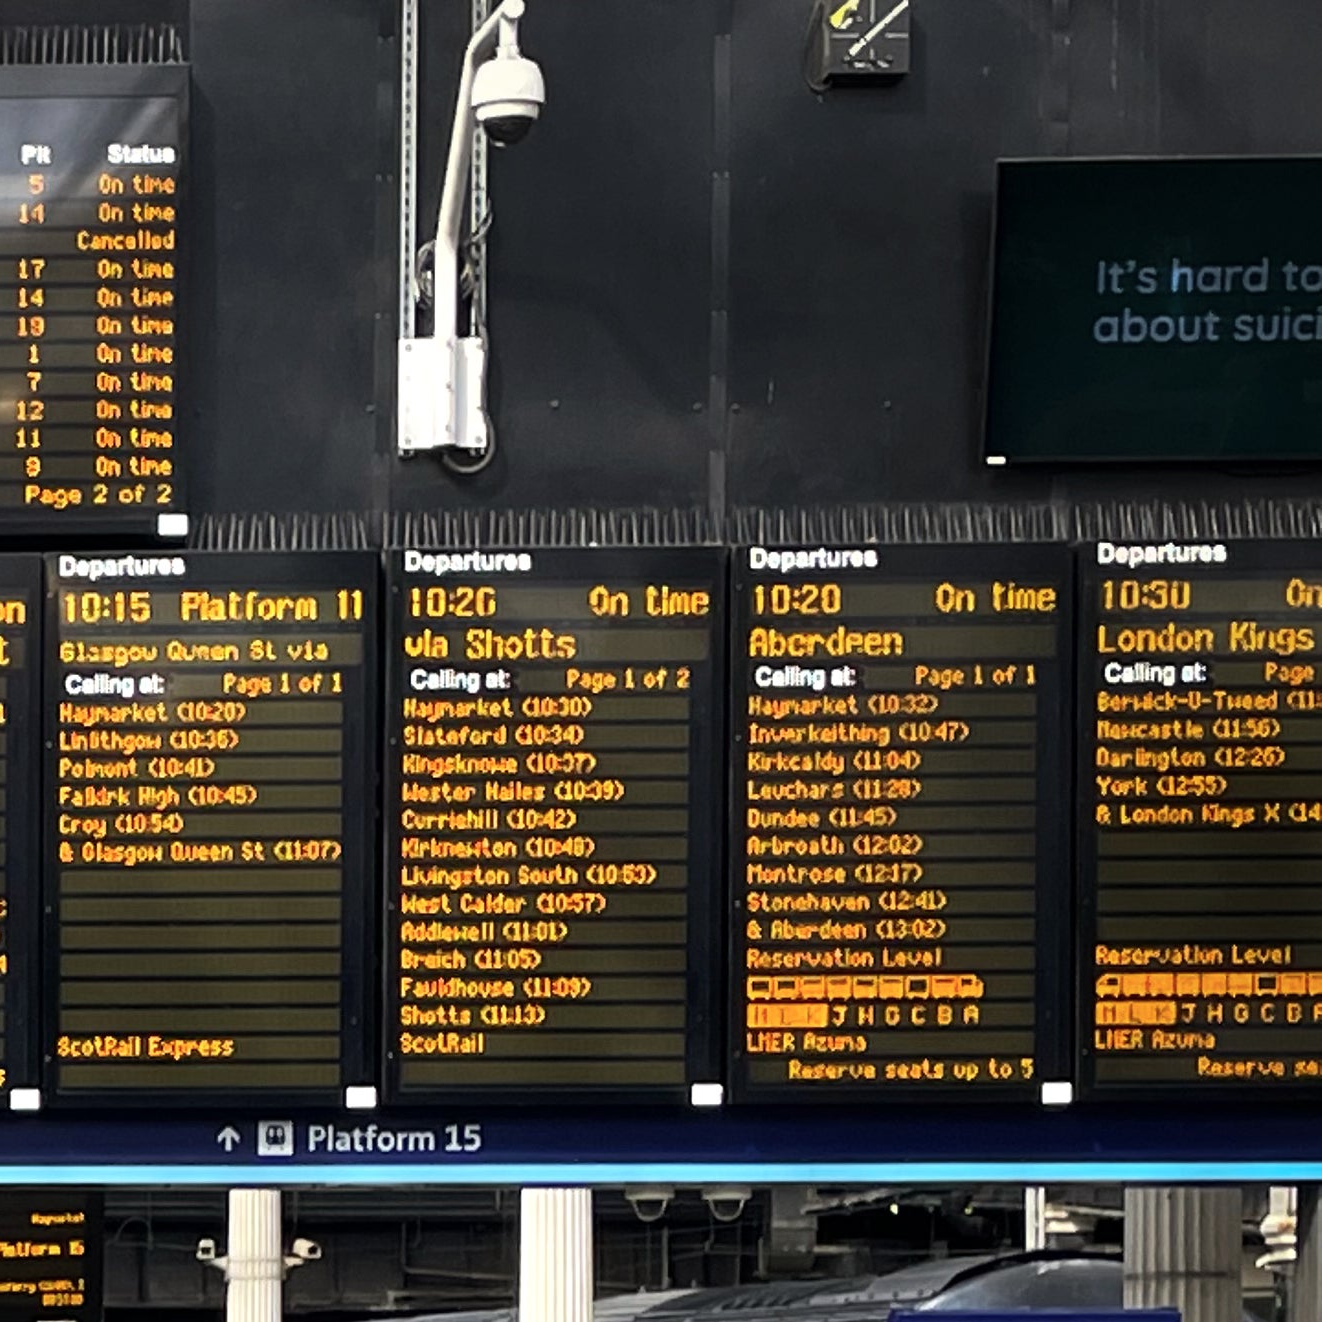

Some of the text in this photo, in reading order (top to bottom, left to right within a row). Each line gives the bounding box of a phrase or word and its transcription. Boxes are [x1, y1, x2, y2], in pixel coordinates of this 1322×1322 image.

[21, 144, 52, 165] Plt
[107, 143, 175, 164] Status
[18, 258, 45, 280] 17
[96, 258, 124, 280] On
[130, 258, 175, 280] time
[1097, 259, 1158, 294] It's
[1170, 257, 1269, 294] hard
[1093, 307, 1221, 343] about
[24, 483, 172, 509] Page 2 of 2
[59, 555, 186, 582] Departures
[404, 549, 532, 577] Departures
[749, 546, 878, 573] Departures
[1097, 542, 1227, 569] Departures
[63, 589, 363, 624] 10:15 Platform 11
[935, 582, 976, 613] On
[992, 582, 1056, 612] time
[308, 1124, 482, 1153] Platform 15
